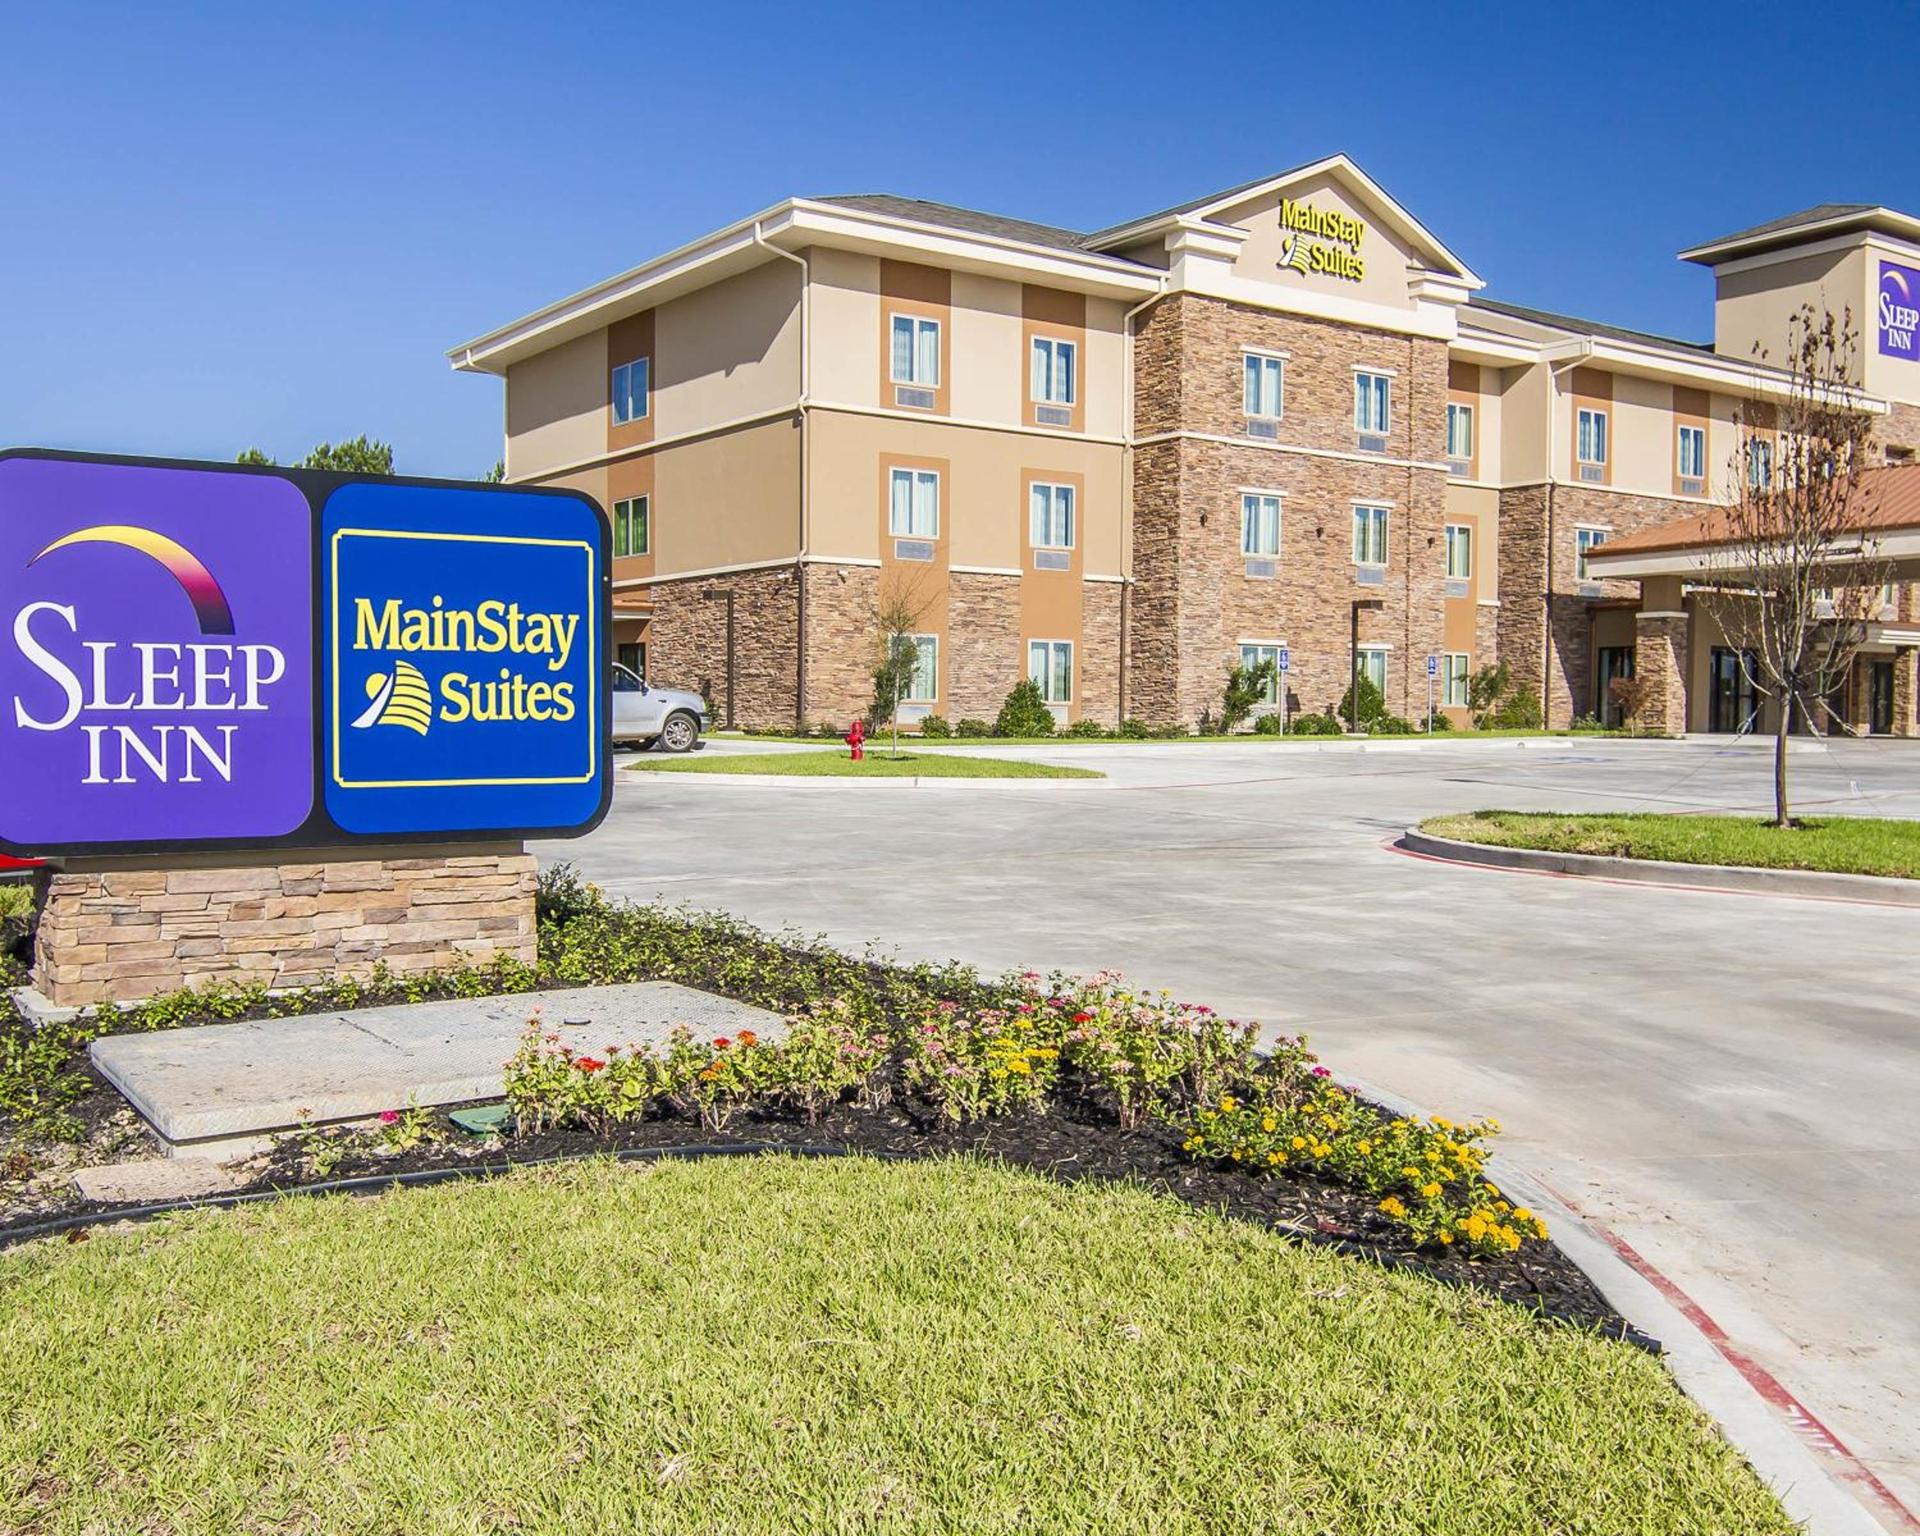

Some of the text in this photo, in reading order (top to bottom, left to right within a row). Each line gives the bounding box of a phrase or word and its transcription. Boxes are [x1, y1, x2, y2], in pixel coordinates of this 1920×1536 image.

[1280, 198, 1366, 250] MainStay
[1309, 243, 1365, 281] Suites
[1880, 291, 1920, 331] SLEEP
[1888, 328, 1912, 350] INN
[353, 594, 580, 671] MainStay
[13, 601, 286, 732] SLEEP
[439, 667, 575, 722] Suites
[80, 725, 239, 784] INN
